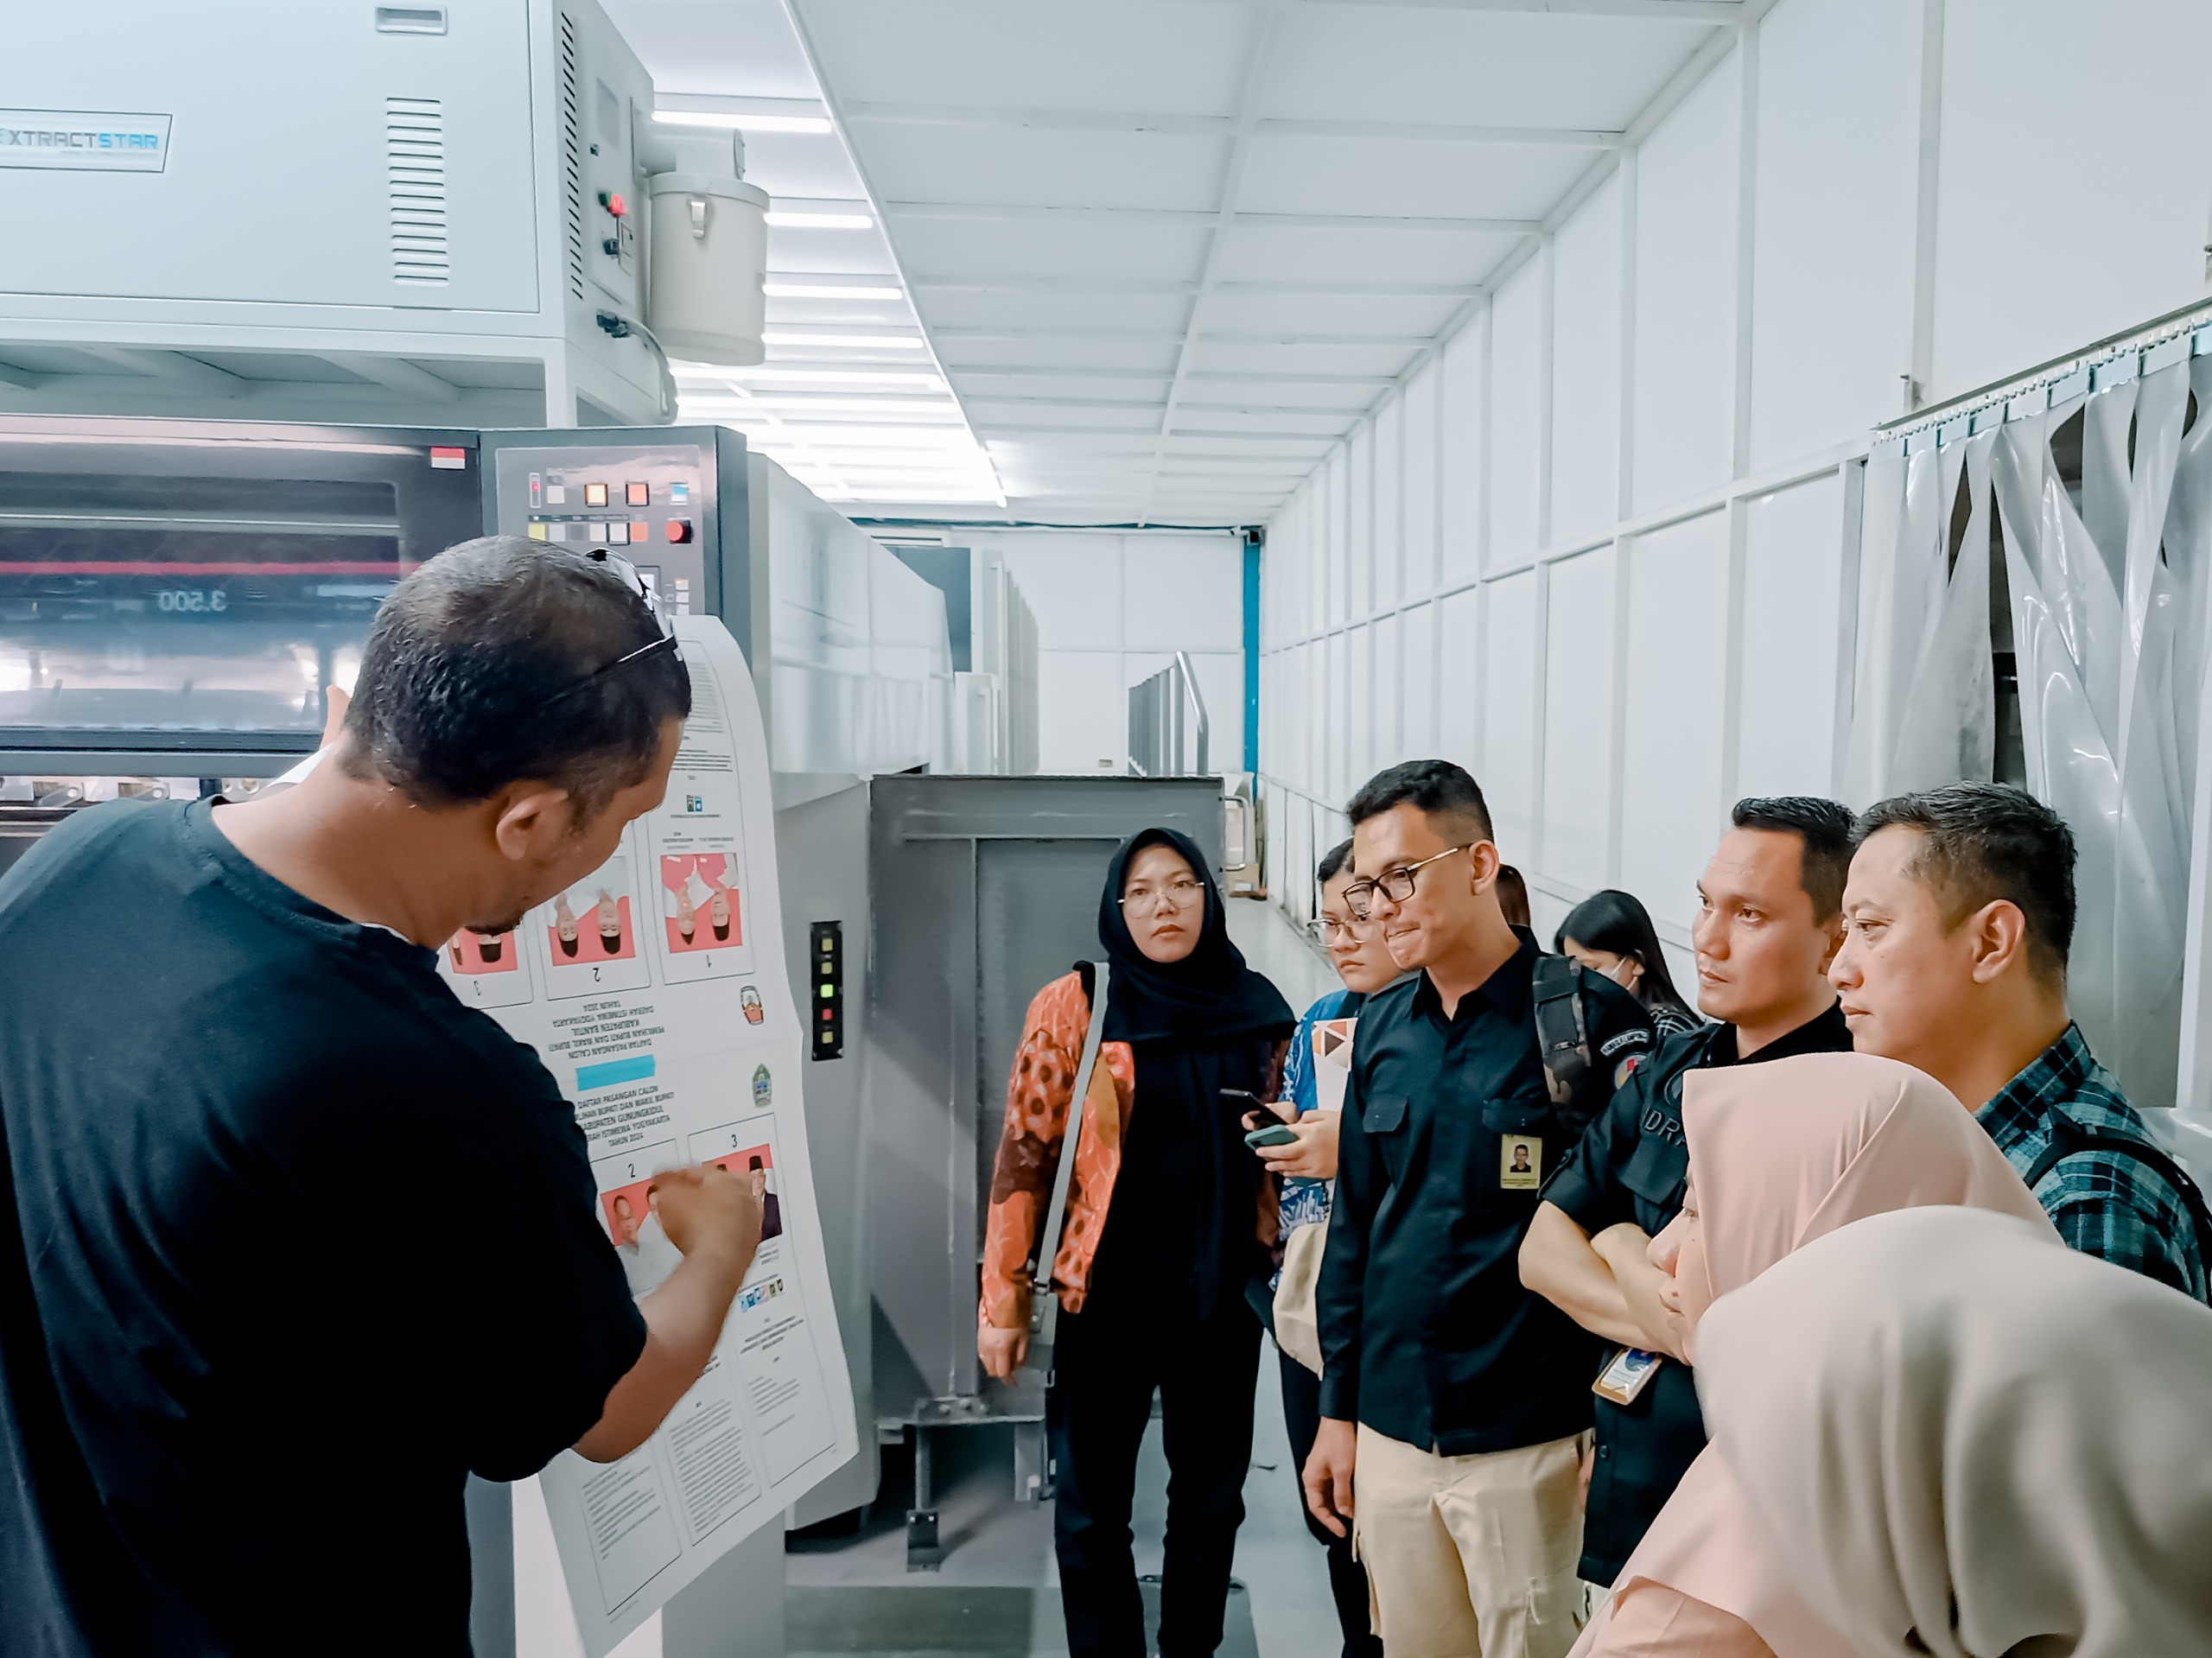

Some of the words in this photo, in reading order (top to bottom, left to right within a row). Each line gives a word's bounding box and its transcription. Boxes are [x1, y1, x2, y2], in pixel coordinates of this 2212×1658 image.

[706, 954, 711, 968] 1
[593, 967, 601, 982] 2
[598, 1009, 627, 1020] ISTIMEWA
[630, 1006, 654, 1017] DAERAH
[553, 1014, 595, 1027] YOGYAKARTA
[601, 1019, 639, 1032] KABUPATEN
[572, 1025, 599, 1036] BANTUL
[611, 1031, 631, 1041] BUPATI
[632, 1026, 664, 1039] PEMILIHAN
[573, 1037, 593, 1048] WAKIL
[594, 1034, 609, 1044] DAN
[628, 1038, 652, 1050] DAFTAR
[549, 1041, 570, 1052] BUPATI
[569, 1047, 591, 1059] CALON
[592, 1042, 627, 1054] PASANGAN
[577, 1097, 601, 1109] DAFTAR
[603, 1089, 638, 1104] PASANGAN
[639, 1085, 658, 1096] CALON
[598, 1105, 619, 1115] BUPATI
[620, 1102, 633, 1110] DAN
[635, 1097, 654, 1107] WAKIL
[655, 1092, 675, 1102] BUPATI
[584, 1116, 616, 1130] ABUPATEN
[618, 1105, 664, 1122] GUNUNGKIDUL
[601, 1125, 631, 1139] ISTIMEWA
[632, 1115, 671, 1130] YOGYAKARTA
[608, 1137, 628, 1147] TAHUN
[629, 1133, 644, 1142] 2024
[731, 1134, 739, 1148] 3
[628, 1163, 636, 1178] 2
